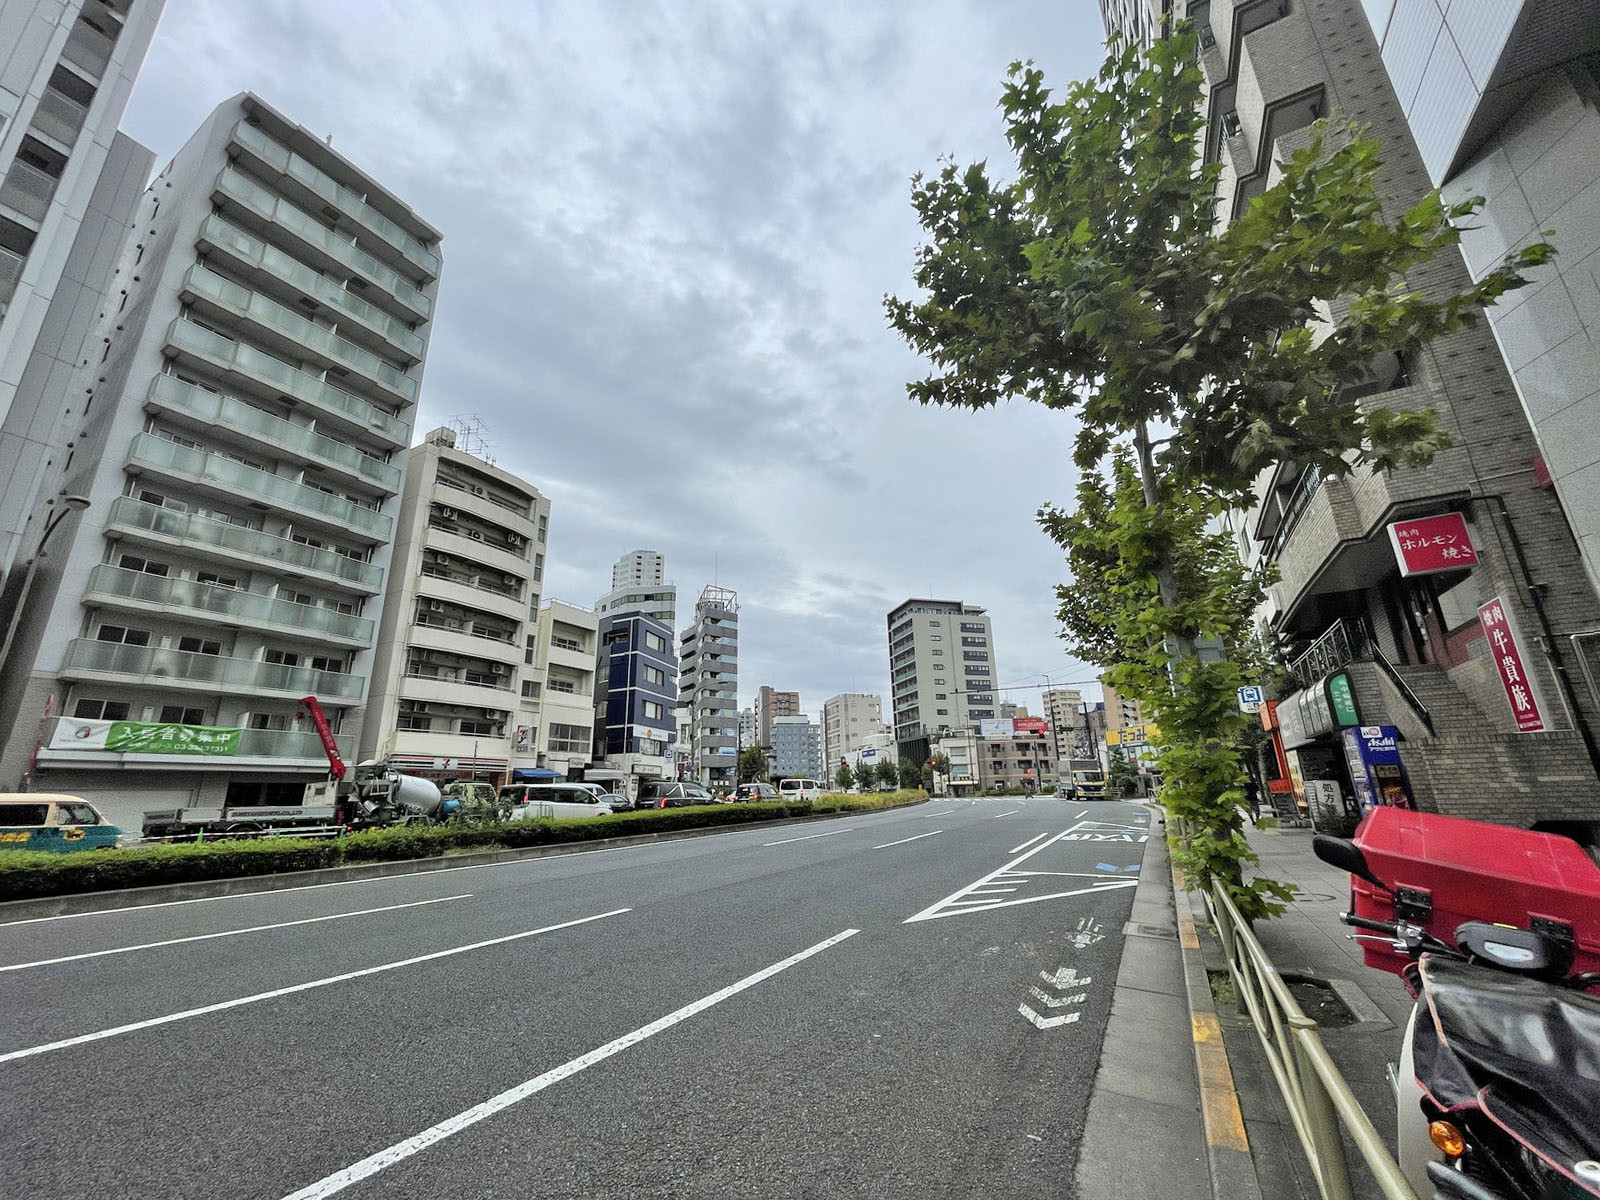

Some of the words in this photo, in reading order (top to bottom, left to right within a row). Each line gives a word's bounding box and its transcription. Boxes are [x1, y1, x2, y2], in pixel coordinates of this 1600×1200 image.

[1399, 528, 1420, 538] 焼肉
[1401, 534, 1458, 551] ホルモン
[1442, 545, 1473, 560] 焼き
[1482, 605, 1504, 627] 焼肉
[1492, 628, 1531, 712] 牛貴族
[1117, 725, 1147, 744] たつみ
[1367, 737, 1395, 747] Asahi
